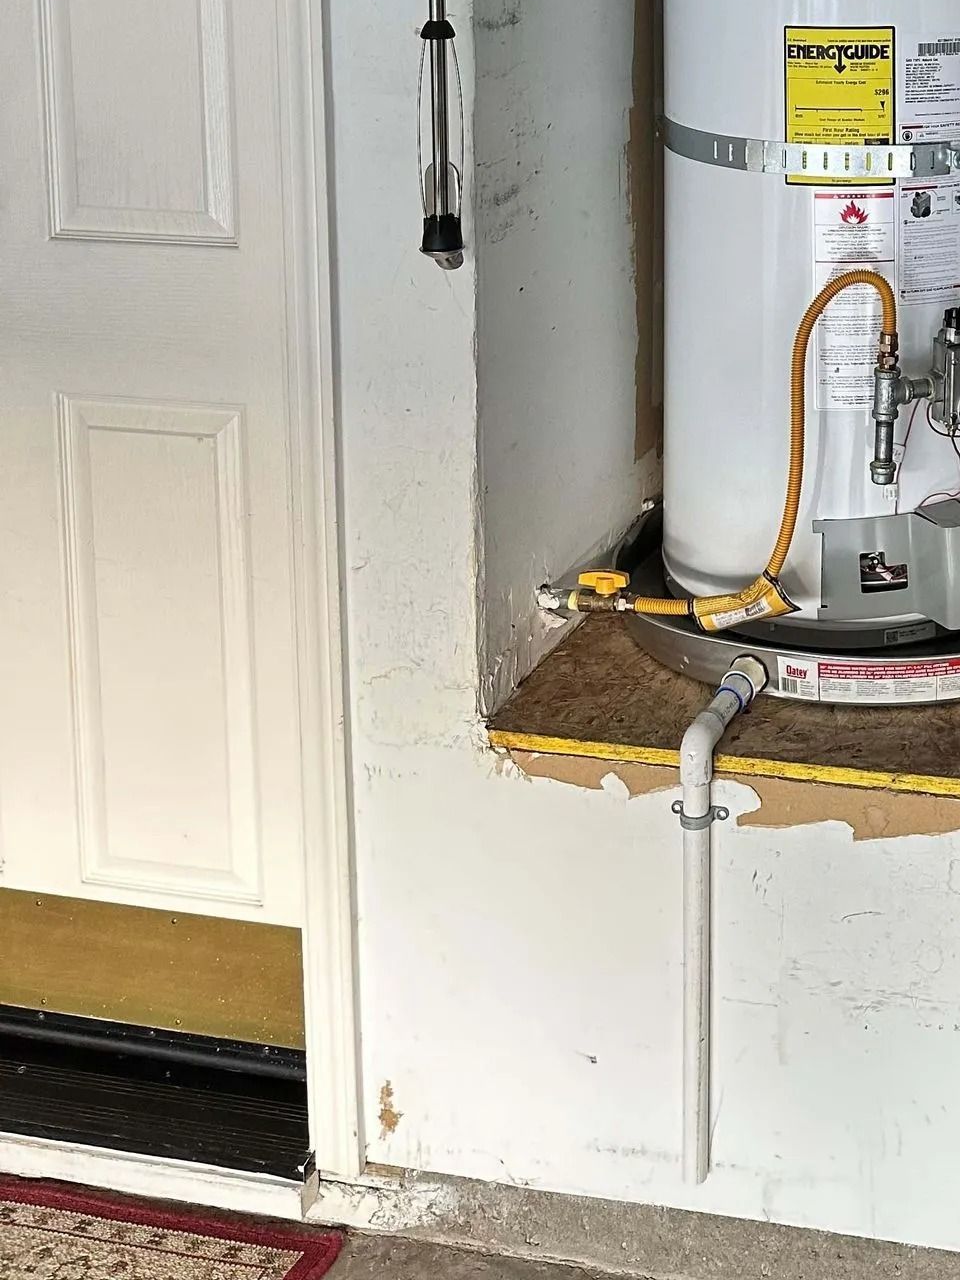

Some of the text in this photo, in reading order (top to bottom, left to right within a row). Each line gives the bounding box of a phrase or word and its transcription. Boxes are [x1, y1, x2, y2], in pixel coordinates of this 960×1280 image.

[787, 44, 890, 60] ENERGYGUIDE
[874, 88, 890, 96] $296
[786, 665, 808, 679] Oatey
